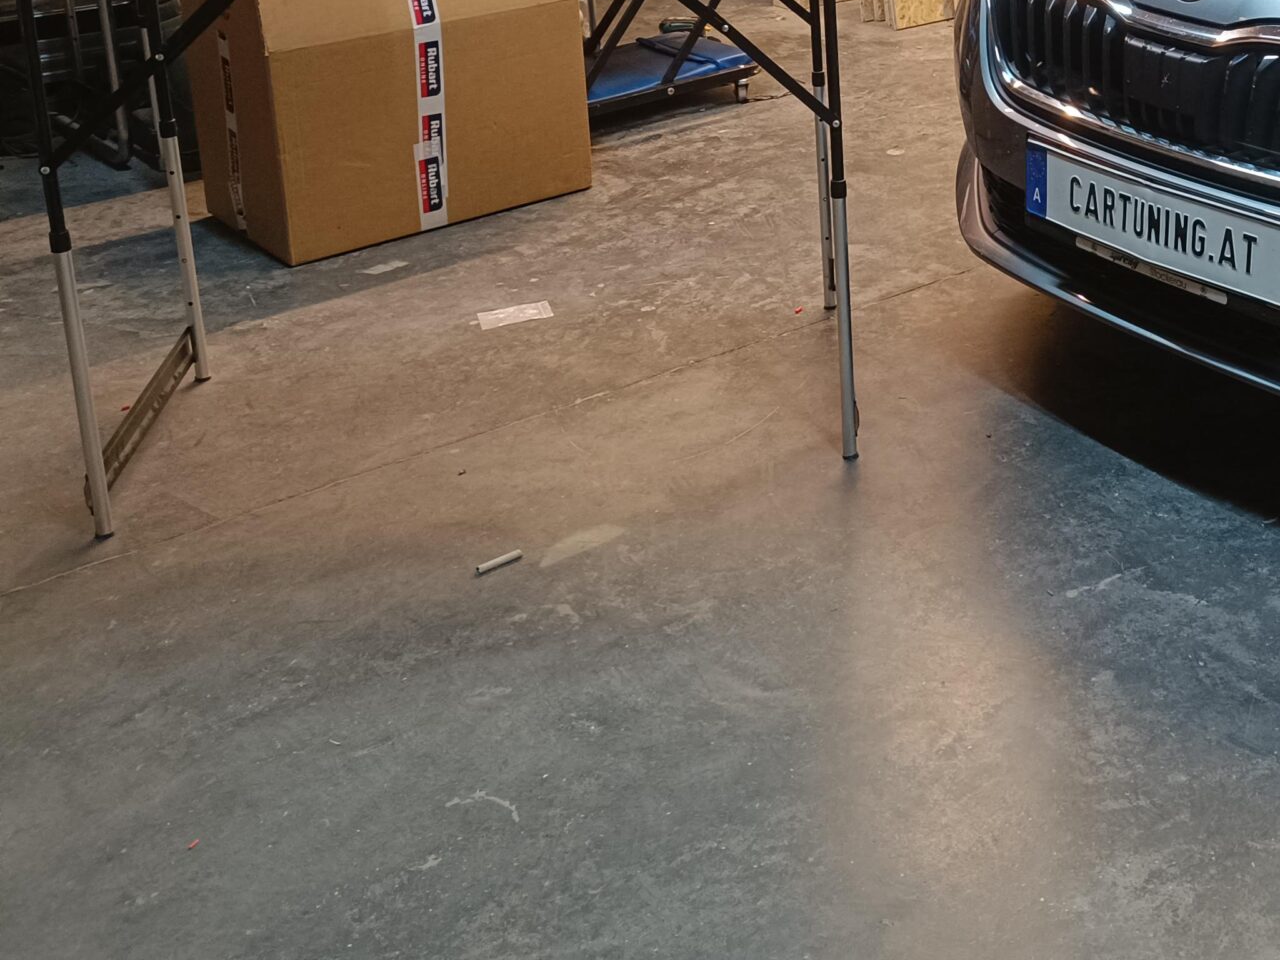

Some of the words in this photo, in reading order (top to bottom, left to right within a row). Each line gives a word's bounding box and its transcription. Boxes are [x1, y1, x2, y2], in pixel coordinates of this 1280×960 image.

[427, 47, 438, 91] Rubart
[428, 163, 440, 206] Rubart
[1032, 187, 1042, 203] A
[1069, 176, 1258, 275] CARTUNING.AT
